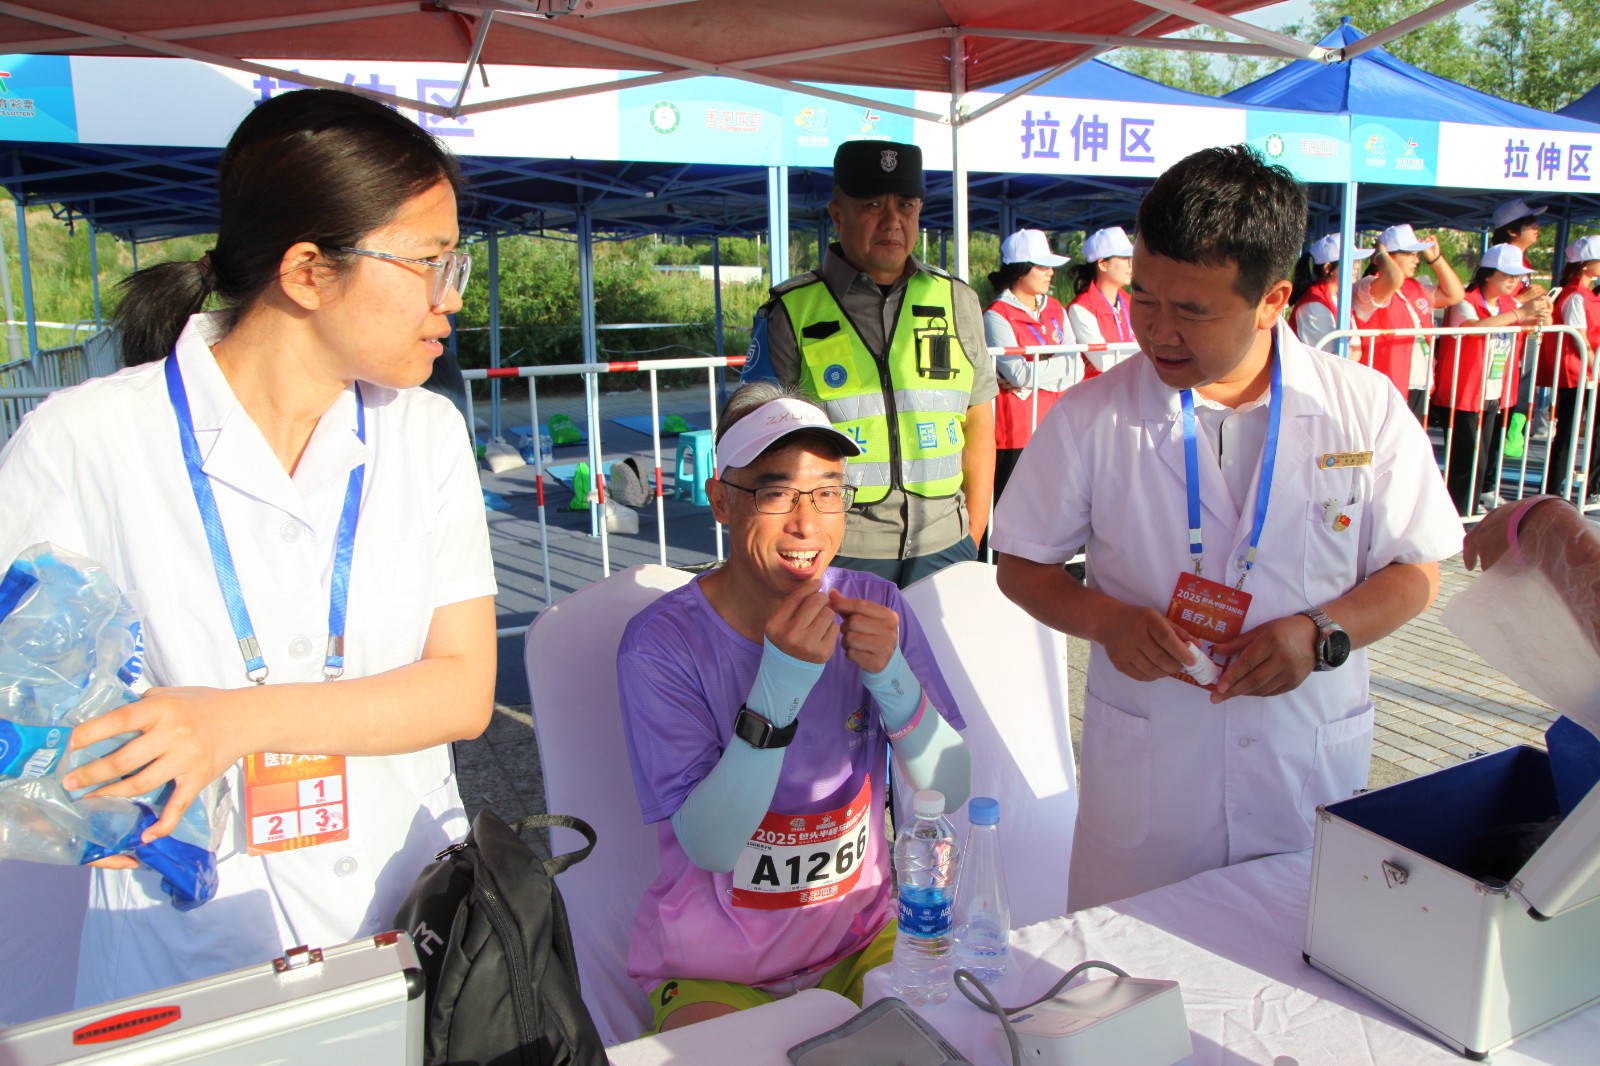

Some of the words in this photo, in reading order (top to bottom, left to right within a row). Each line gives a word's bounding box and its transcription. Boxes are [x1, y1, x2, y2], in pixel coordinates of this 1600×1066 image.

[1020, 110, 1155, 163] 拉伸区
[1504, 138, 1592, 181] 拉伸区
[1176, 588, 1201, 604] 2025
[1181, 608, 1228, 634] 医疗人员
[313, 779, 325, 798] 1
[268, 815, 284, 836] 2
[315, 808, 330, 827] 3
[756, 828, 797, 845] 2025
[751, 825, 867, 886] A1266
